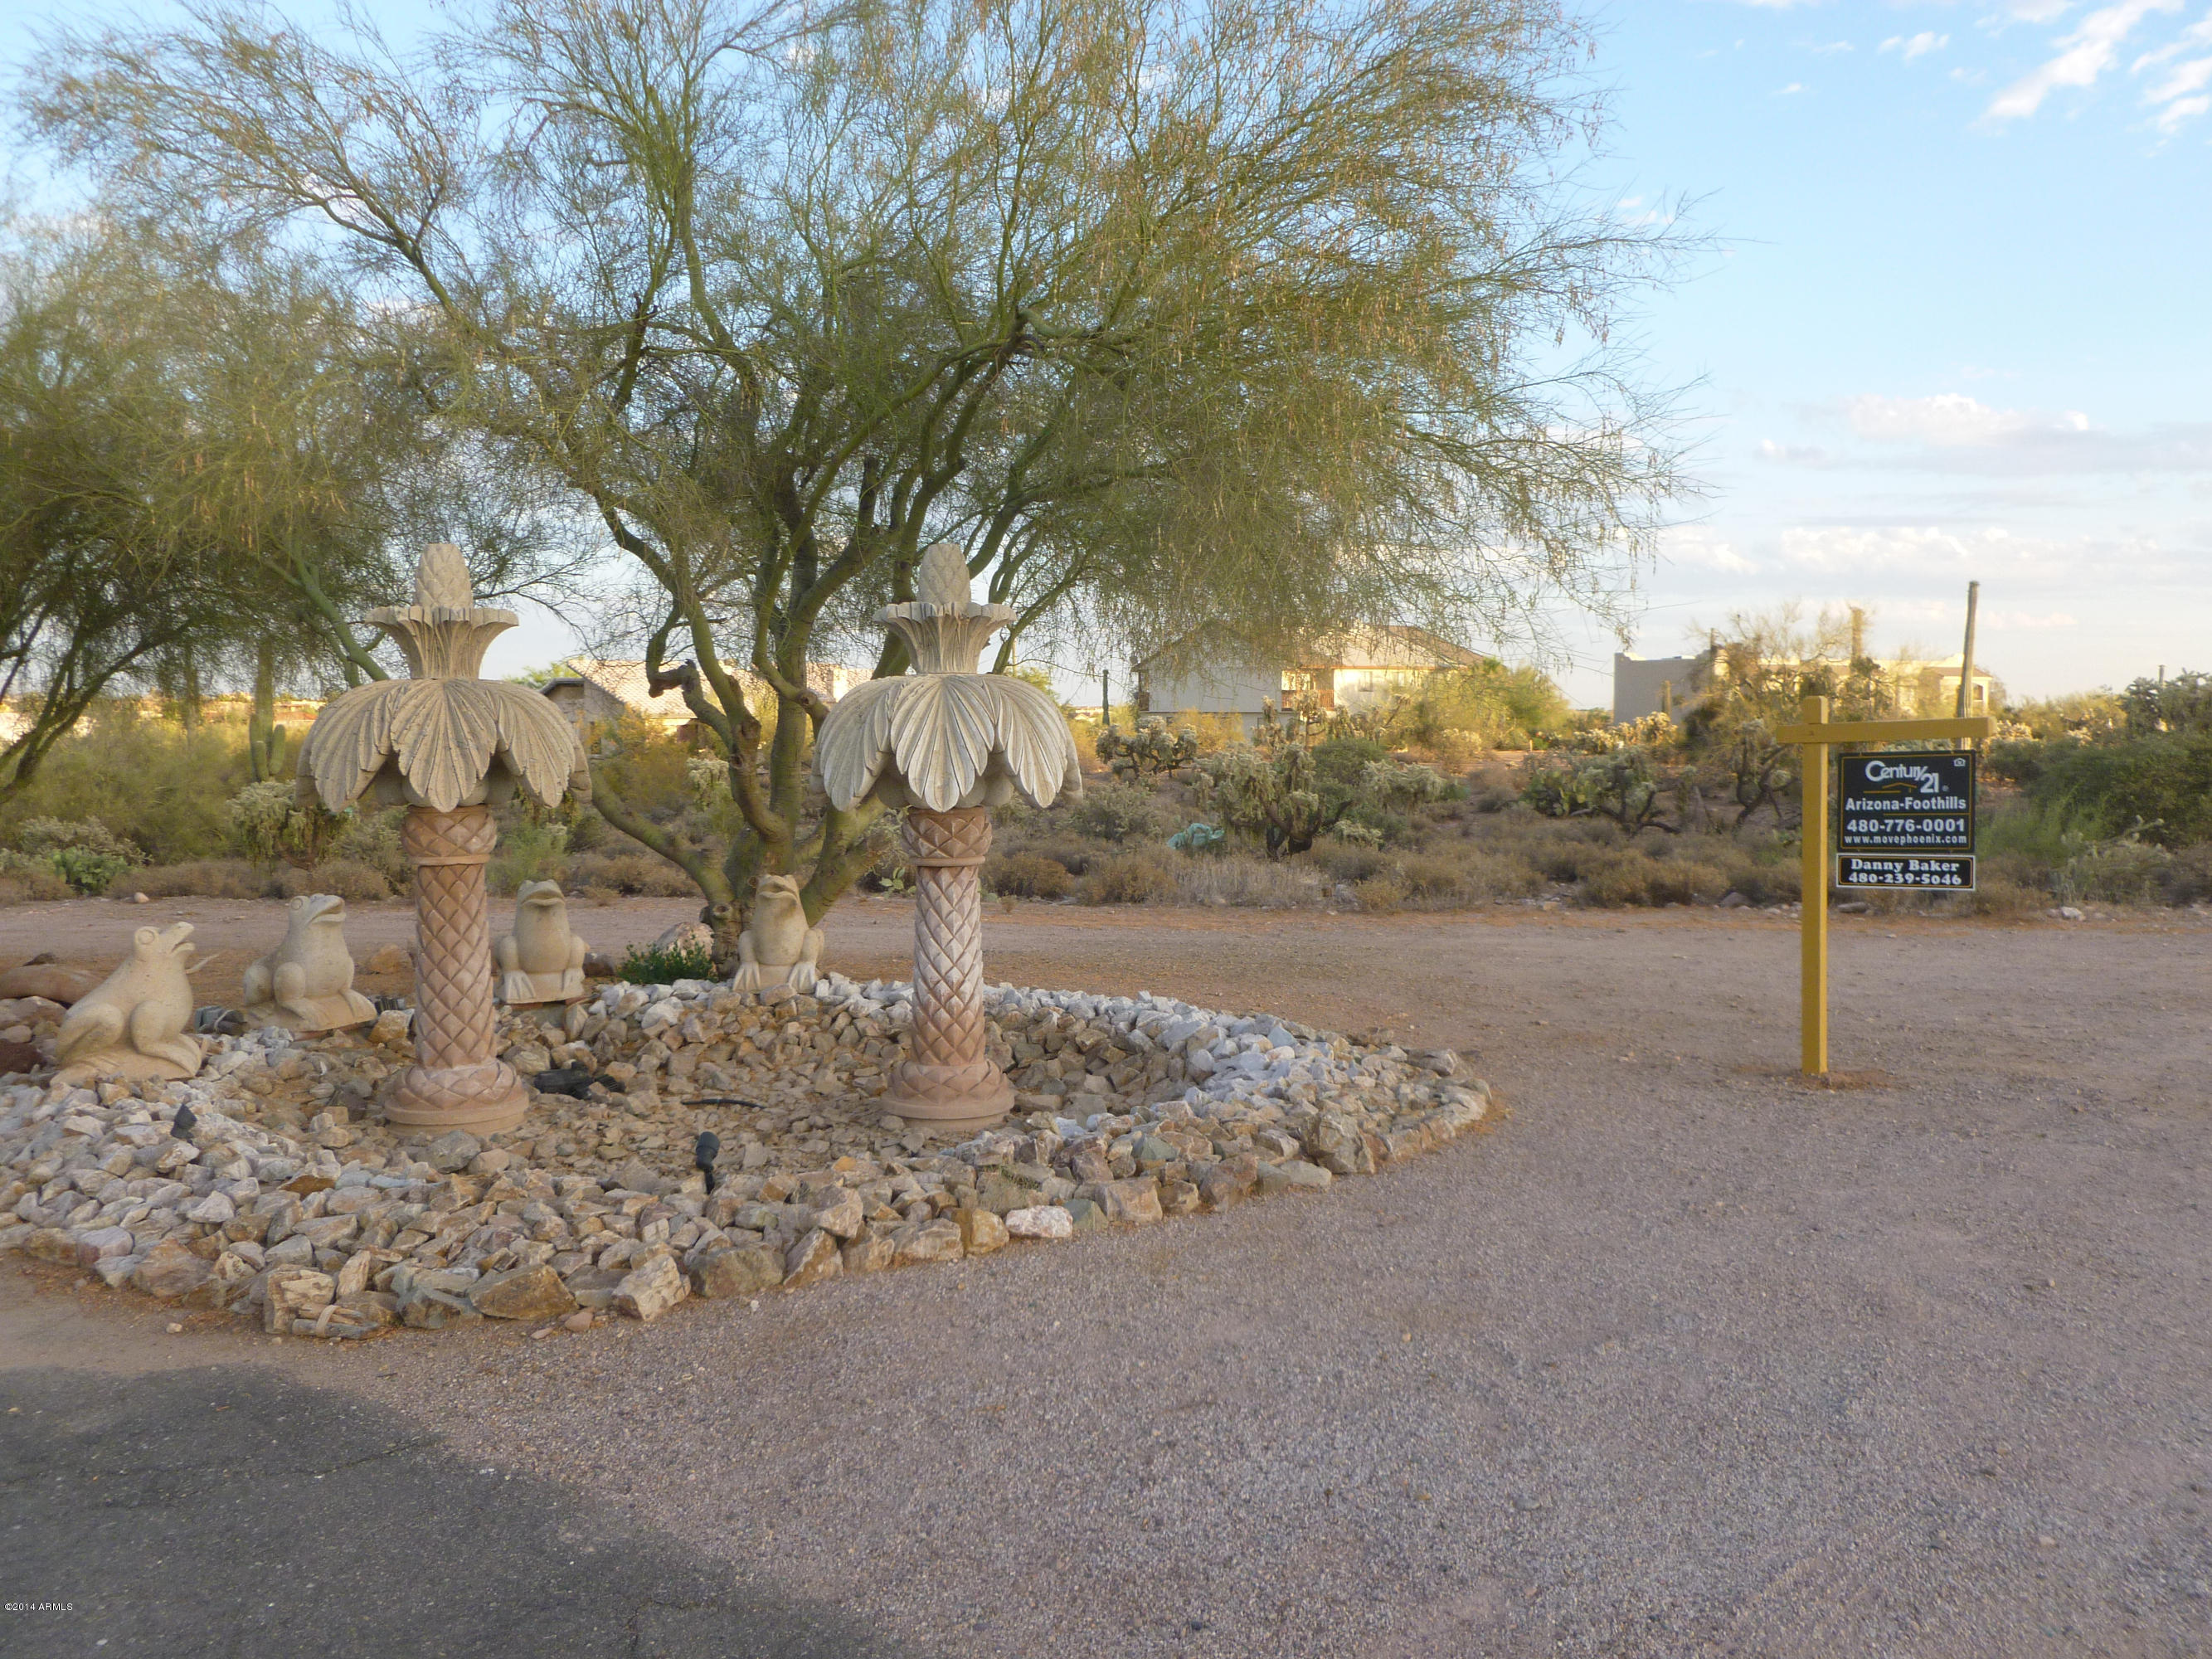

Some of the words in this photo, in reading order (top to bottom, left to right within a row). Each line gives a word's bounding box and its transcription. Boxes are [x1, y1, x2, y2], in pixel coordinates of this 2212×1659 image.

[1864, 760, 1928, 781] Century
[1919, 772, 1939, 794] 21
[1845, 795, 1966, 810] Arizona-Foothills
[1847, 818, 1966, 833] 480-776-0001
[1844, 834, 1967, 845] www.movephoenix.com
[1850, 859, 1903, 873] Danny
[1908, 859, 1960, 872] Baker
[1849, 873, 1962, 885] 480-239-5046
